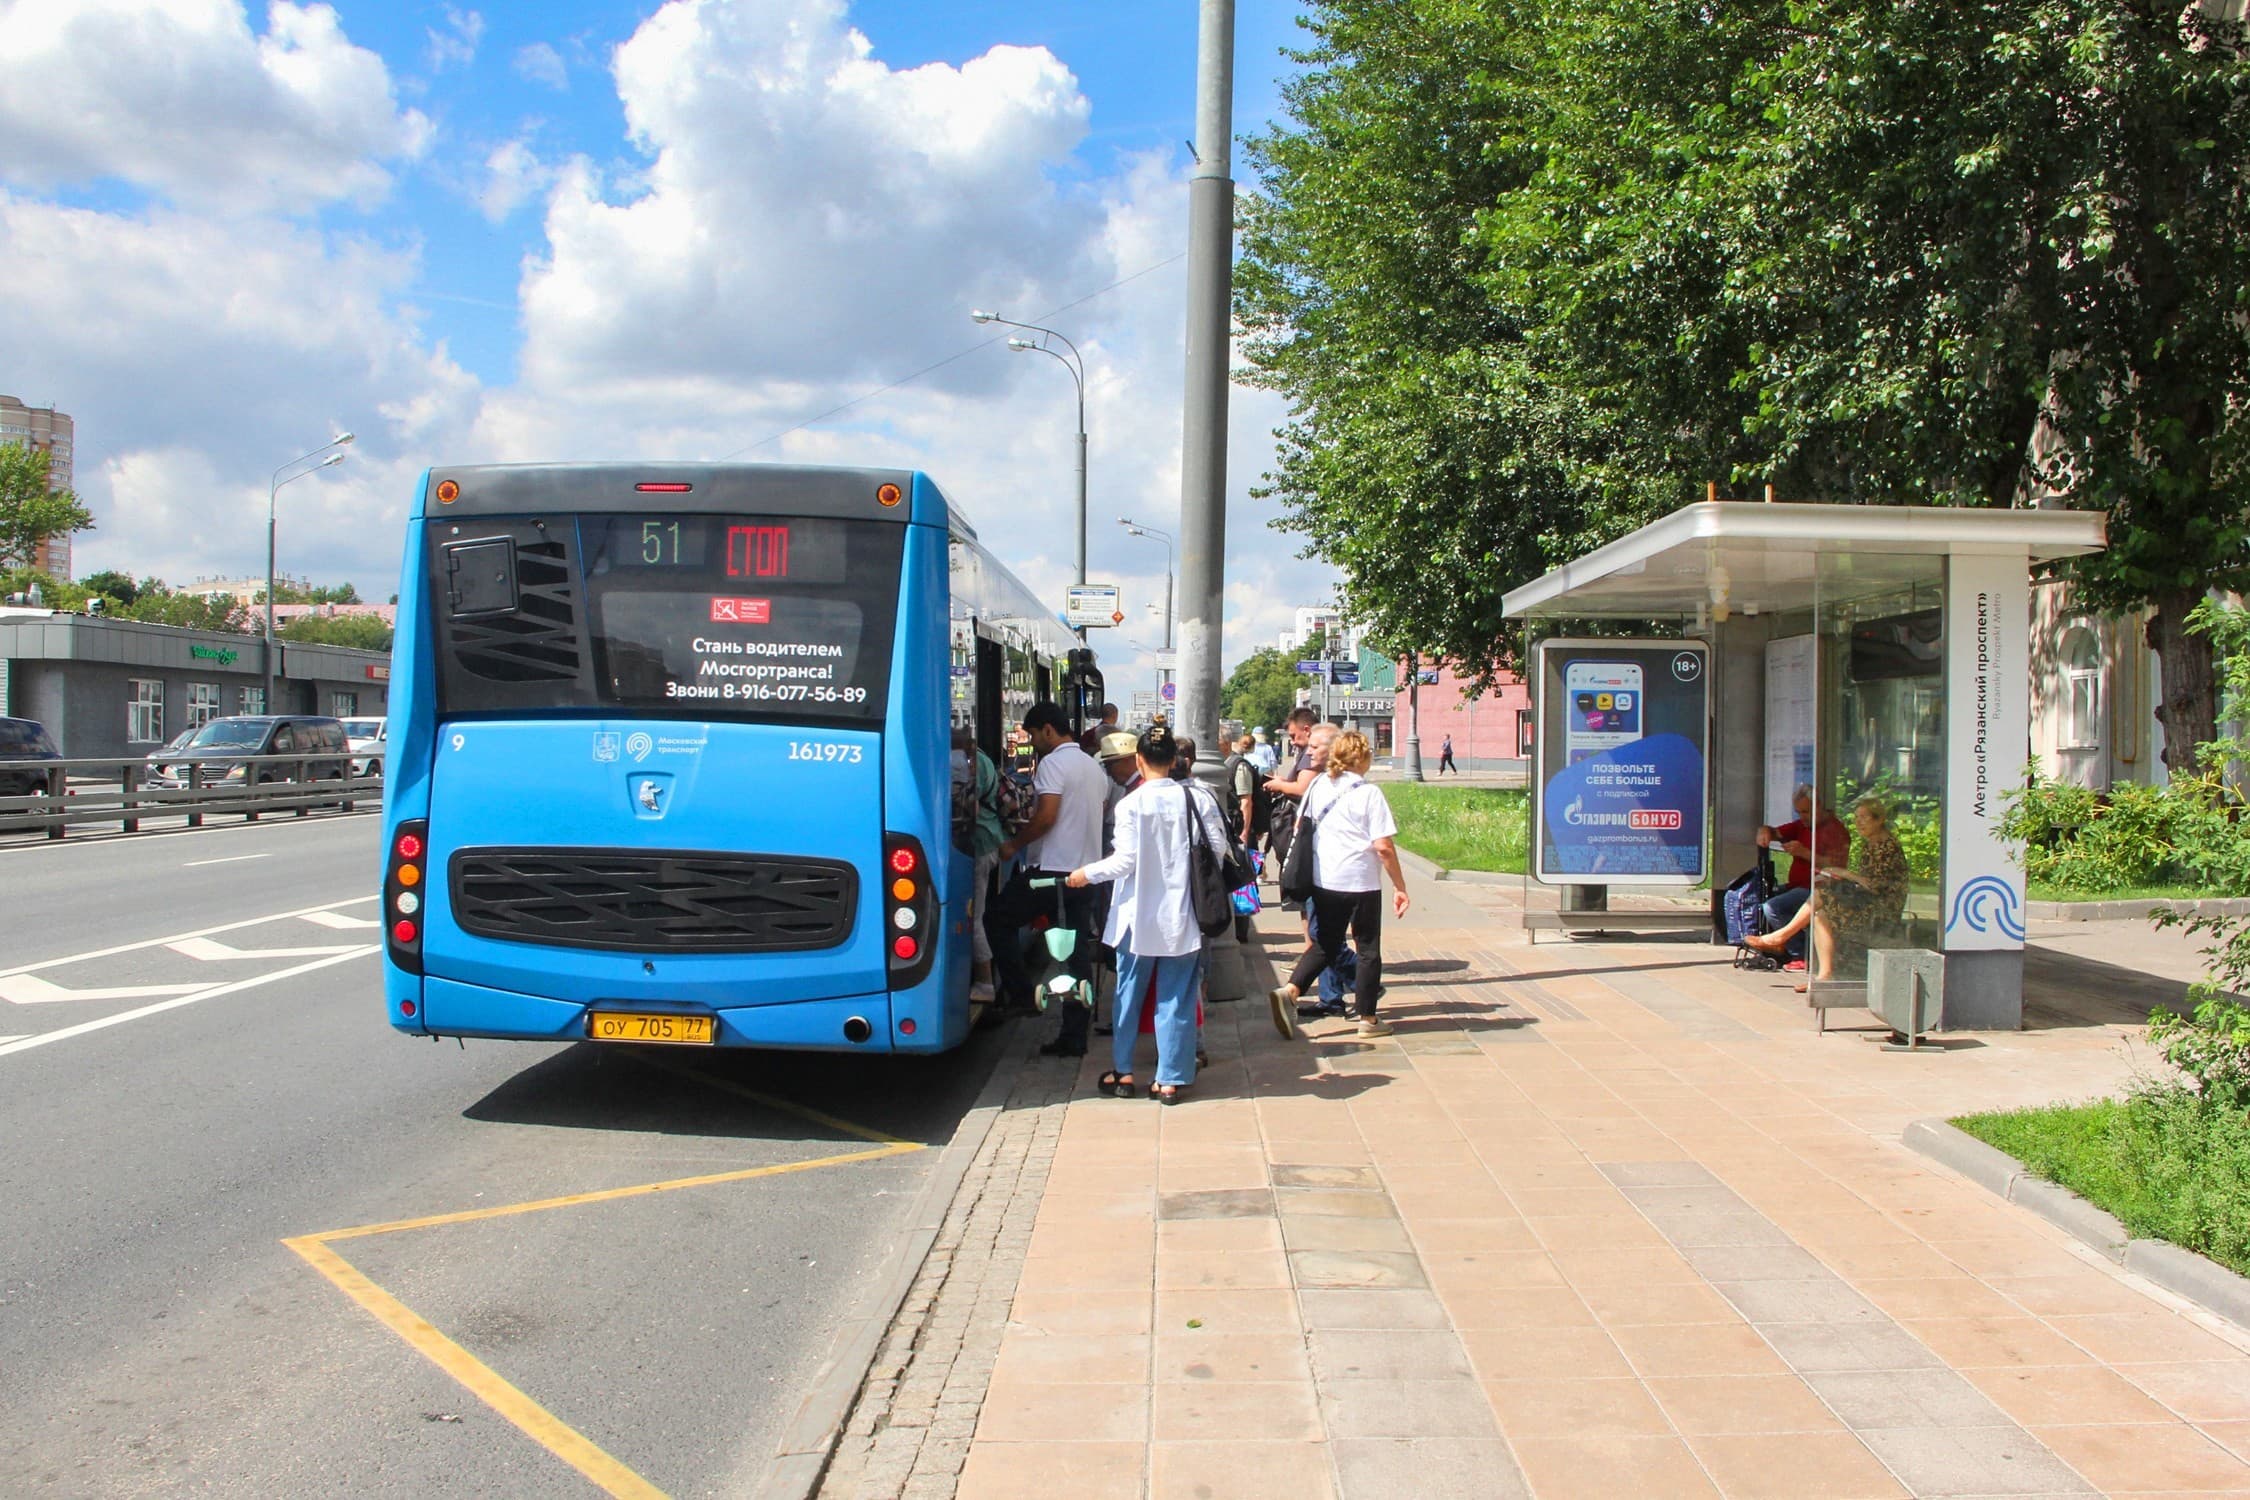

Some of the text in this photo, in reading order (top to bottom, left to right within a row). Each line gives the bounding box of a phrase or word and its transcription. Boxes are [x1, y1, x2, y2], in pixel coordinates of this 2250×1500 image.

[642, 521, 679, 564] 51
[726, 526, 789, 577] СТОП
[692, 638, 843, 658] Стань водителем
[1992, 592, 2002, 720] Ryazansky Prospekt Metro
[700, 660, 833, 681] Мосгортранса!
[1676, 661, 1697, 672] 18+
[665, 682, 867, 703] Звони 8-916-077-56-89
[1339, 700, 1384, 711] ЦВЕТЫ
[1973, 592, 1990, 818] Метро «Рязанский проспект»
[452, 734, 465, 752] 9
[657, 736, 708, 746] Московский
[657, 746, 700, 756] транспорт
[788, 741, 863, 763] 161973
[1592, 764, 1656, 774] ПОЗВОЛЬТЕ
[1585, 775, 1661, 785] СЕБЕ БОЛЬШЕ
[1603, 789, 1650, 799] подпиской
[1582, 813, 1678, 826] ГАЗПРОМ БОНУС
[1587, 834, 1658, 844] gazprombonus.ru
[637, 1018, 673, 1038] 705
[684, 1018, 704, 1033] 77
